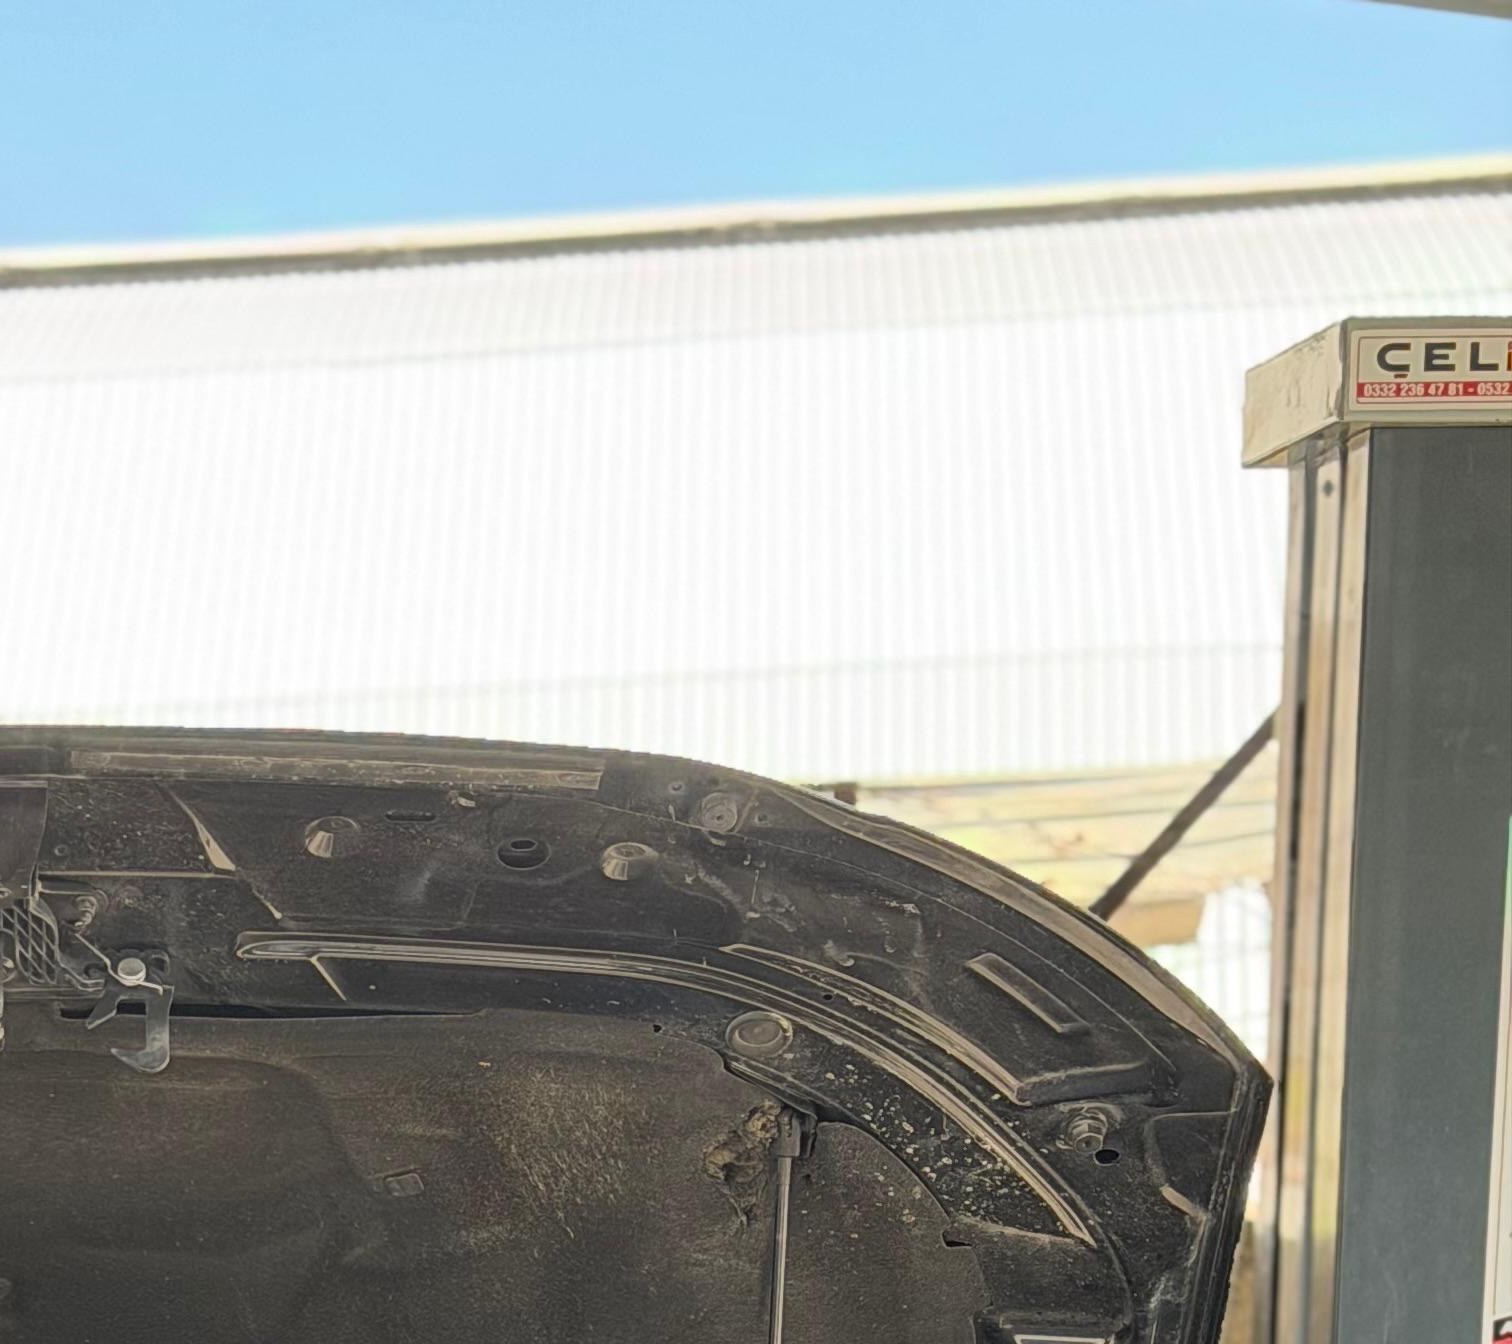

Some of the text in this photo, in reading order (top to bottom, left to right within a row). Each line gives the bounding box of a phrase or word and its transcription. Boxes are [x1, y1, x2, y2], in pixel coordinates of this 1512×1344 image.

[1363, 383, 1396, 397] 0332
[1399, 383, 1425, 396] 236
[1428, 383, 1445, 396] 47
[1448, 383, 1464, 395] 81
[1477, 382, 1510, 395] 0532
